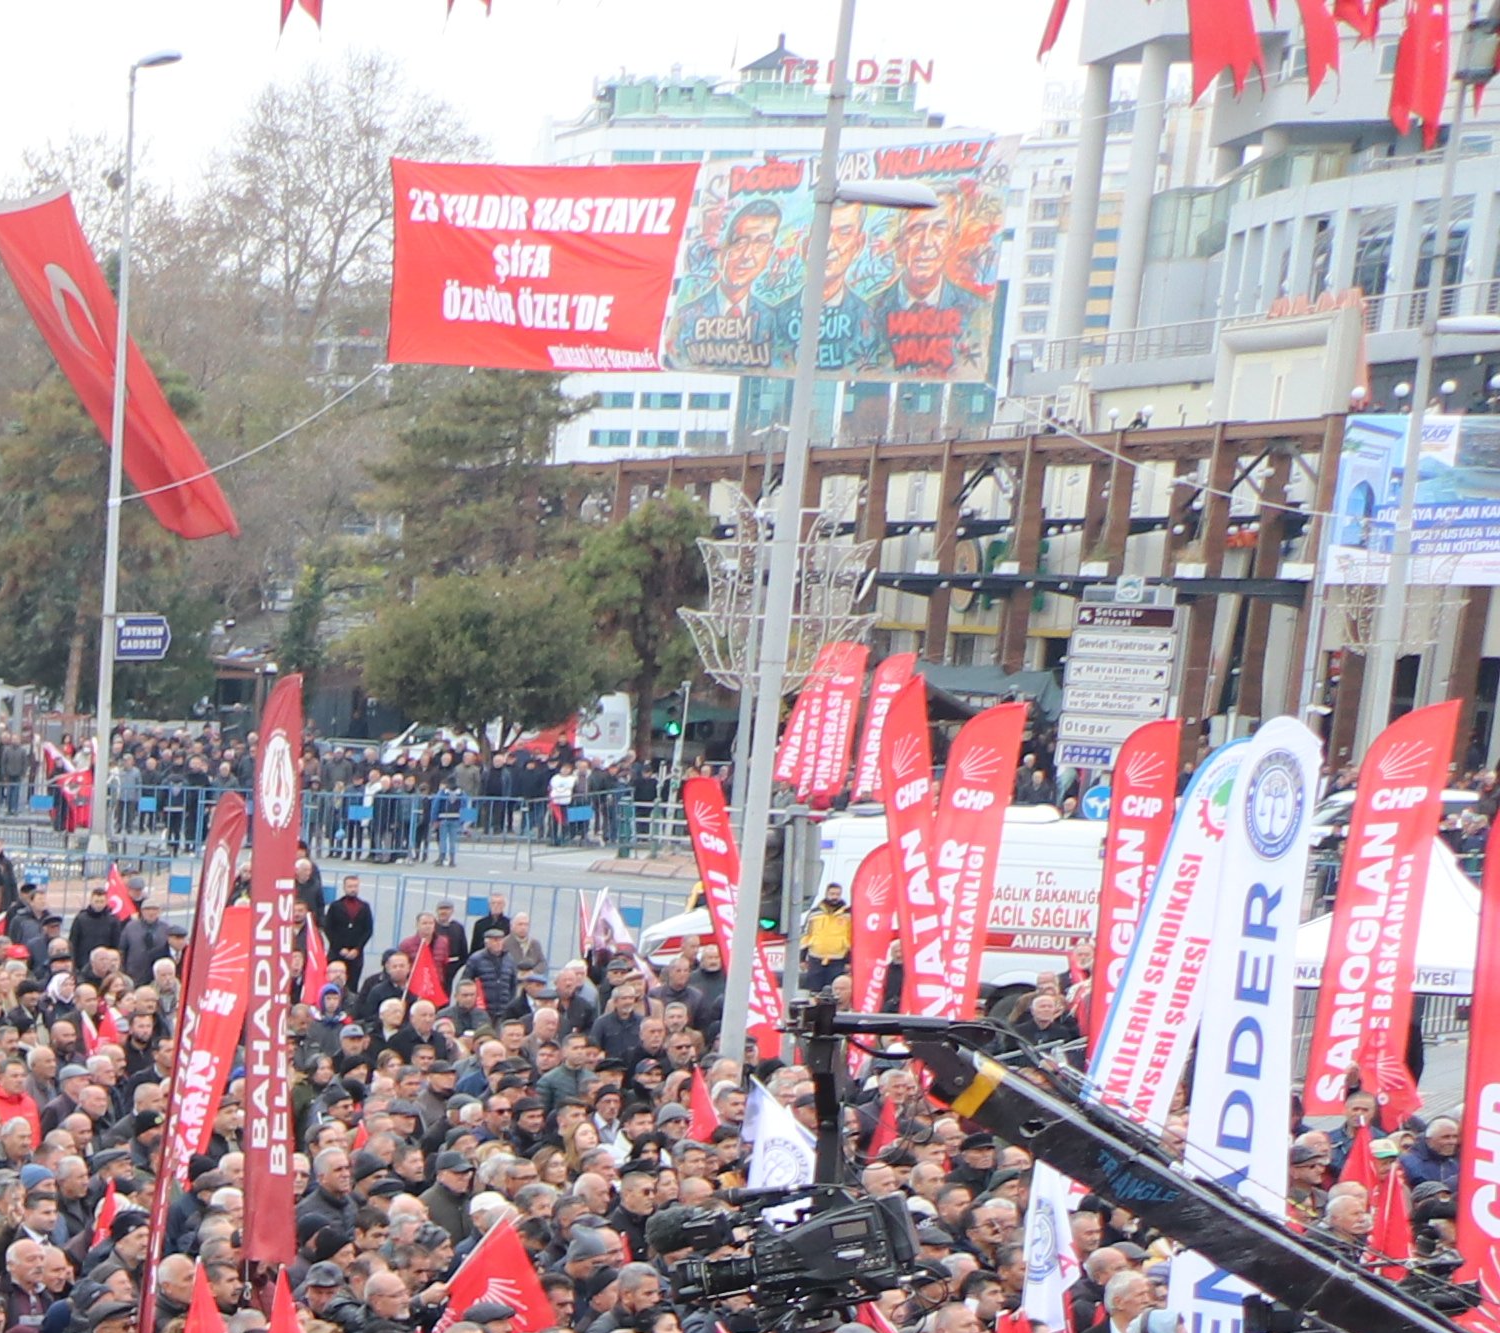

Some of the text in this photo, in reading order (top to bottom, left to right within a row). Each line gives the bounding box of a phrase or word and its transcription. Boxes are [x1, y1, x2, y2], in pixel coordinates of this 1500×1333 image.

[808, 152, 870, 190] DVAR
[408, 187, 676, 235] 23 YILDIR HASTAYIZ
[492, 239, 553, 284] ŞİFA
[442, 280, 614, 332] ÖZGÜR ÖZEL'DE
[695, 315, 753, 340] EKREM
[788, 309, 852, 340] ÖGÜR
[1065, 720, 1111, 735] Otogar
[895, 777, 929, 810] CHP
[953, 787, 994, 810] CHP
[1122, 794, 1163, 818] CHP
[1372, 786, 1428, 810] CHP
[699, 831, 728, 855] CHP
[1036, 872, 1057, 886] T.C.
[900, 829, 948, 1019] VATAN
[990, 904, 1092, 929] ACİL SAĞLIK
[1144, 853, 1203, 984] SENDİKASI
[1165, 936, 1211, 1025] ŞUBESİ
[1414, 971, 1457, 987] DİYESİ
[251, 902, 274, 1149] BAHADIN
[270, 878, 294, 1176] BELEDİYESİ
[1102, 990, 1158, 1114] EKLİLERİN
